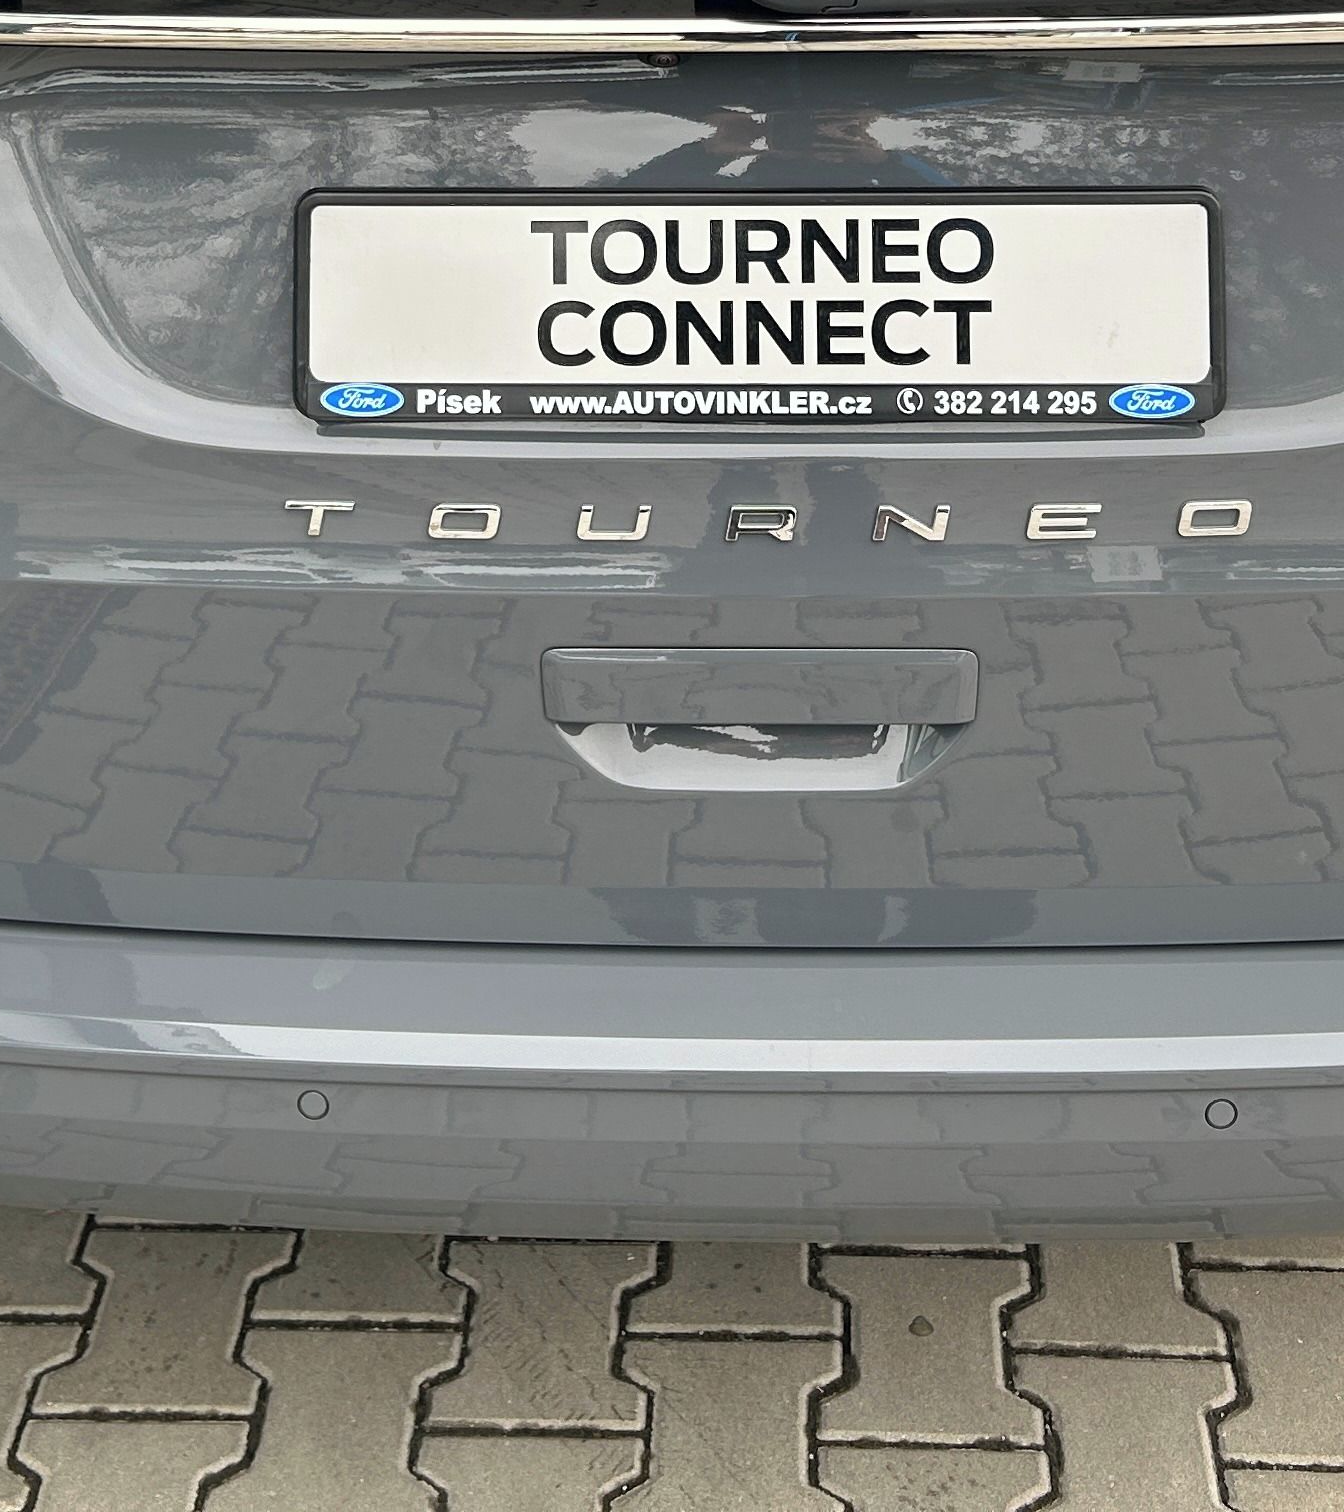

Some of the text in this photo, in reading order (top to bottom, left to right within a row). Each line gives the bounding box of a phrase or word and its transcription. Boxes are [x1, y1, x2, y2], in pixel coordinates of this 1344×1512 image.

[531, 218, 994, 286] TOURNEO
[537, 299, 992, 367] CONNECT
[416, 389, 502, 415] Písek
[529, 389, 872, 415] www.AUTOVINKLER.cz
[933, 389, 983, 415] 382
[990, 390, 1040, 415] 214
[1047, 390, 1097, 414] 295
[283, 497, 1253, 543] TOURNEO
